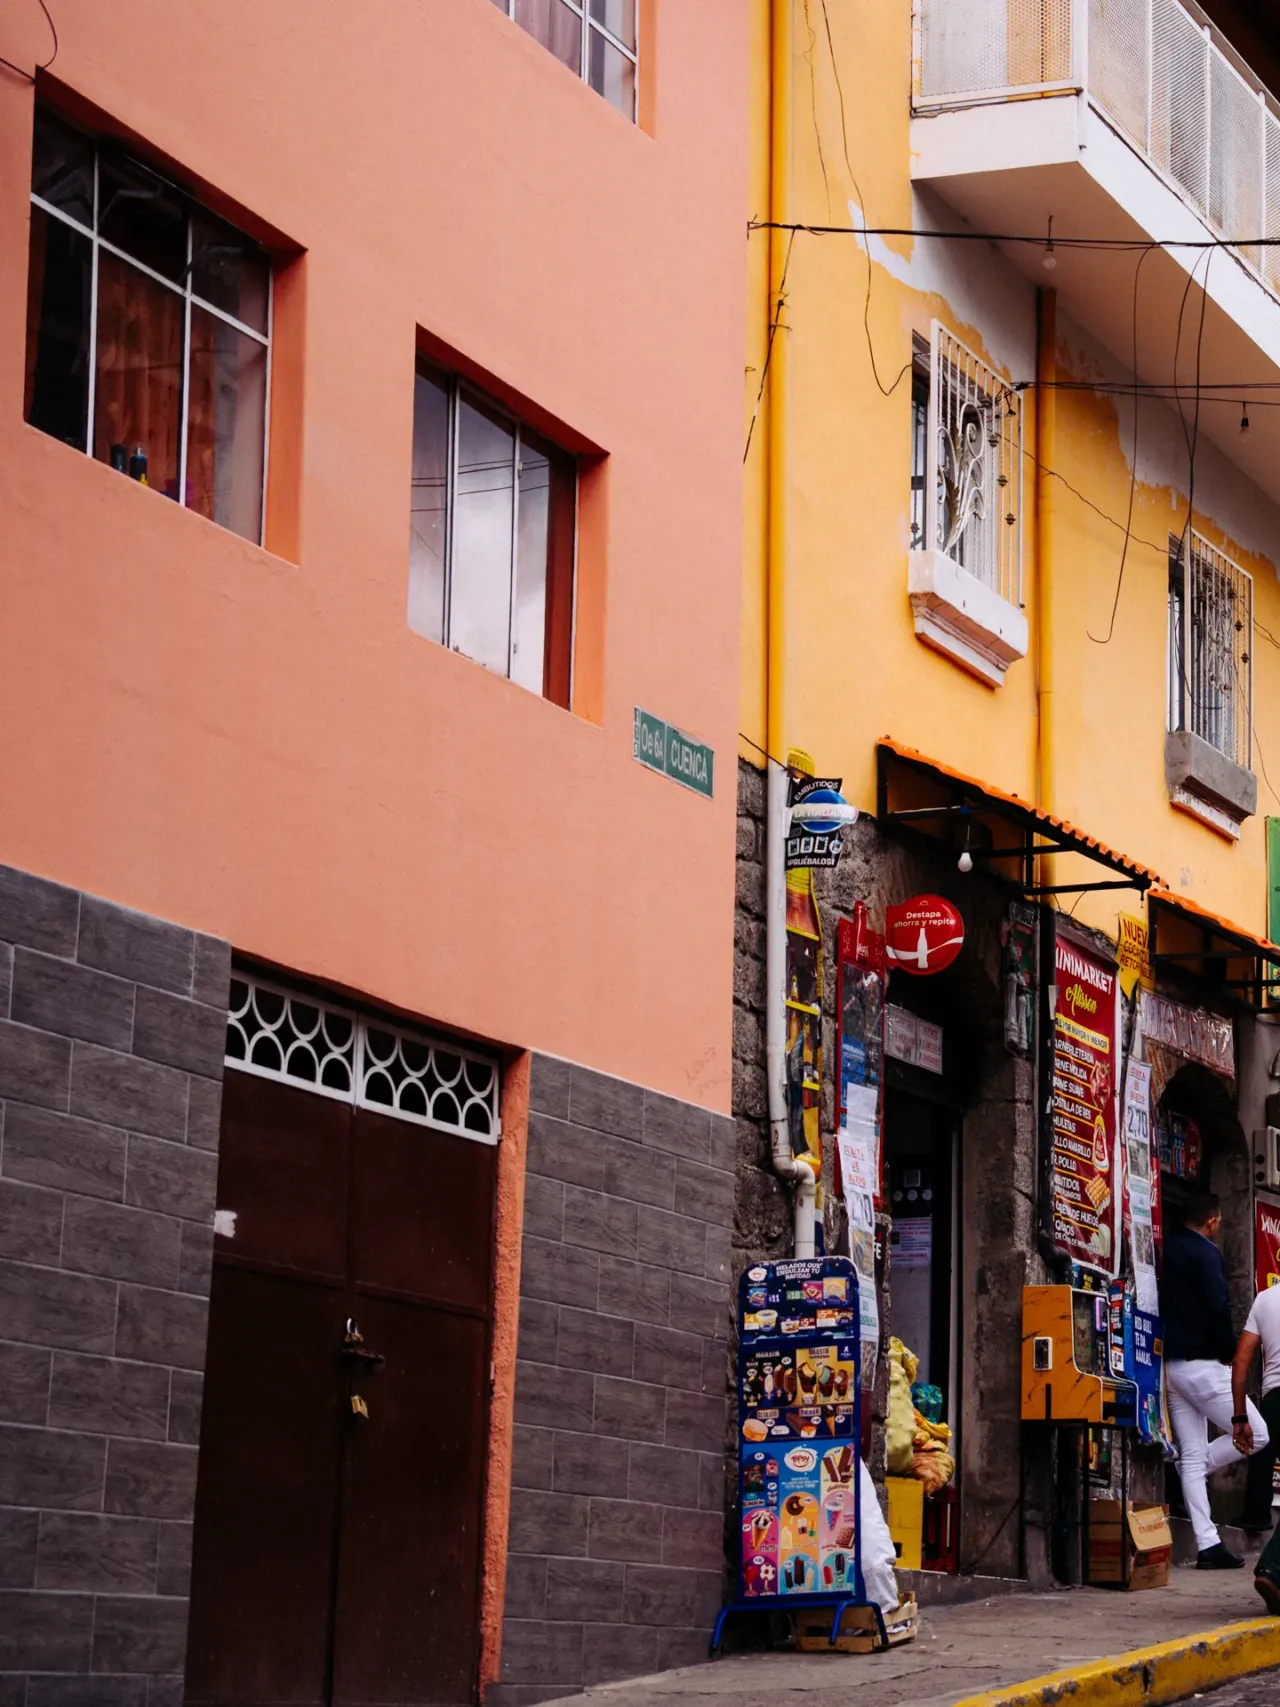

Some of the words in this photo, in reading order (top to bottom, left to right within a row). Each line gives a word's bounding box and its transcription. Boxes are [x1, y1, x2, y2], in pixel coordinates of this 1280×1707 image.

[641, 723, 653, 754] Oe
[671, 740, 708, 784] CUENCA
[794, 781, 839, 801] EMBUTIDOS
[893, 920, 919, 928] ahorra
[928, 918, 956, 926] repite
[906, 911, 941, 919] Destapa
[1053, 1116, 1076, 1133] HULETAS
[1128, 1106, 1149, 1138] 2,70
[776, 1262, 806, 1271] HELADOS
